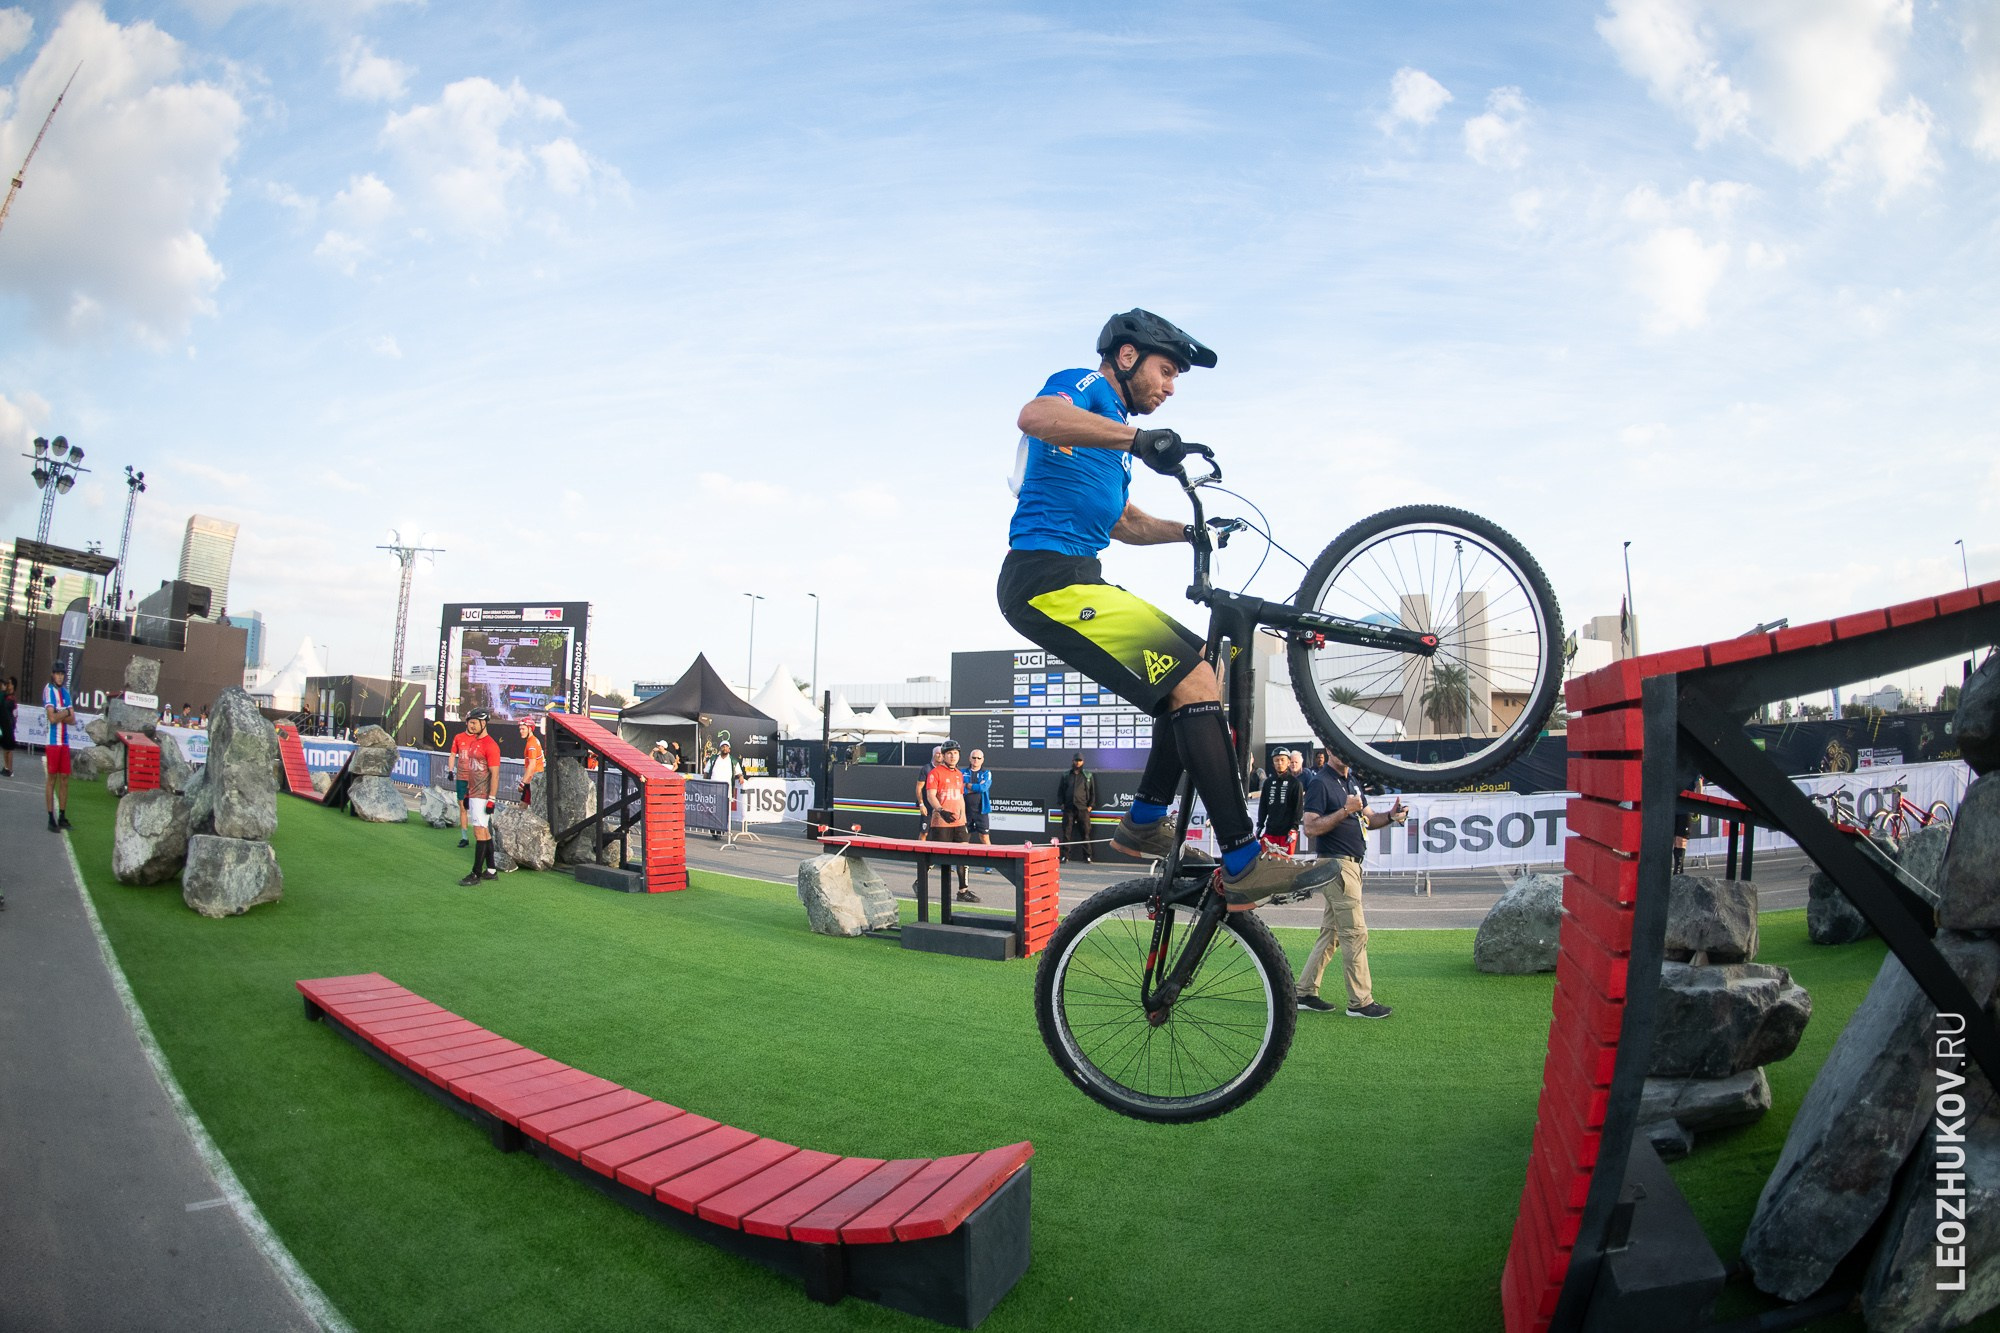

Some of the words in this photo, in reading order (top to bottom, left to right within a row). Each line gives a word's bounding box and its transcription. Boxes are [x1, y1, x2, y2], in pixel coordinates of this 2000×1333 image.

[465, 609, 480, 619] UCI
[1020, 655, 1042, 666] UCI
[66, 652, 74, 690] habi2024
[437, 640, 448, 707] #Abudhabi2024
[572, 641, 583, 714] #Abudhabi2024
[1860, 750, 1872, 758] UCI
[392, 757, 419, 778] ANO
[682, 793, 694, 802] bu
[694, 793, 717, 804] Dhabi
[740, 788, 809, 813] TISSOT
[1119, 793, 1134, 801] Abu
[685, 803, 696, 811] orts
[1000, 805, 1043, 813] CHAMPIONSHIPS
[1191, 815, 1205, 825] CI
[1379, 808, 1567, 855] TISSOT
